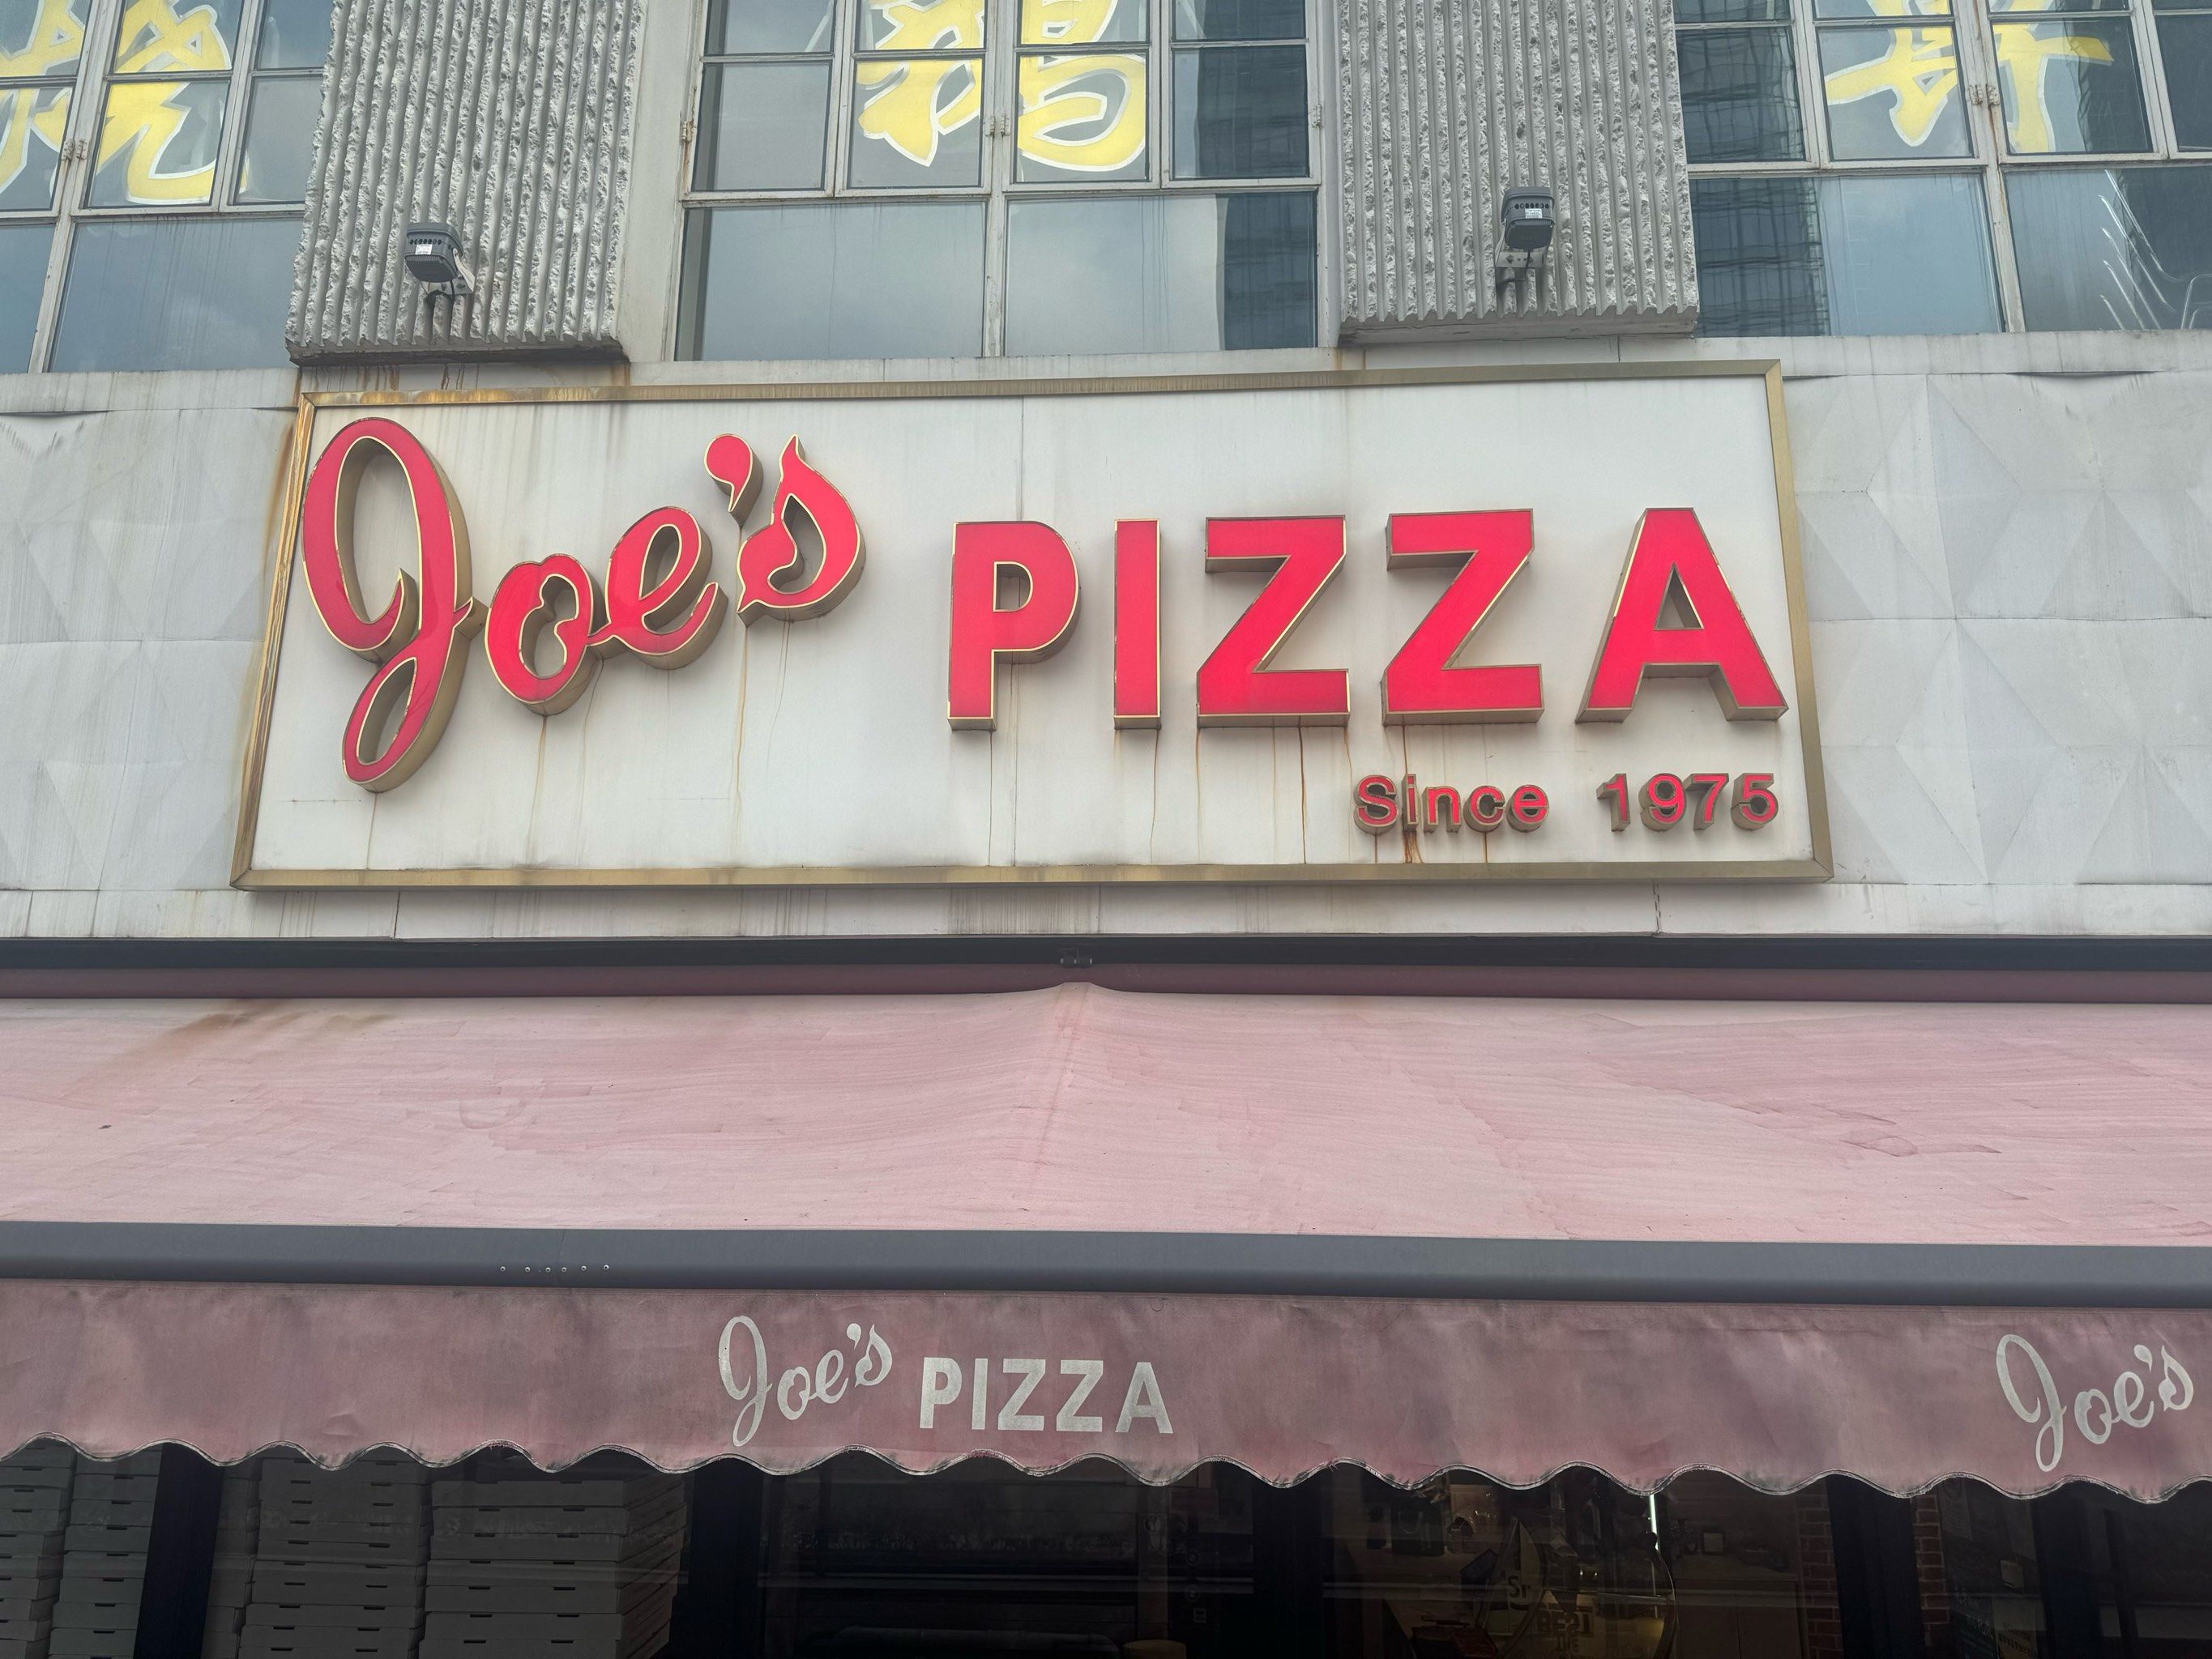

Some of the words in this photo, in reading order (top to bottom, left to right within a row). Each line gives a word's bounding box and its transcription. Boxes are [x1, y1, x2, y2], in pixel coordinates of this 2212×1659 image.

[302, 416, 866, 794] Joe's
[946, 507, 1789, 730] PIZZA
[1353, 773, 1549, 834] Since
[1596, 773, 1779, 833] 1975
[718, 1315, 893, 1448] Joe's
[919, 1357, 1174, 1434] PIZZA
[1996, 1333, 2194, 1473] Joe's
